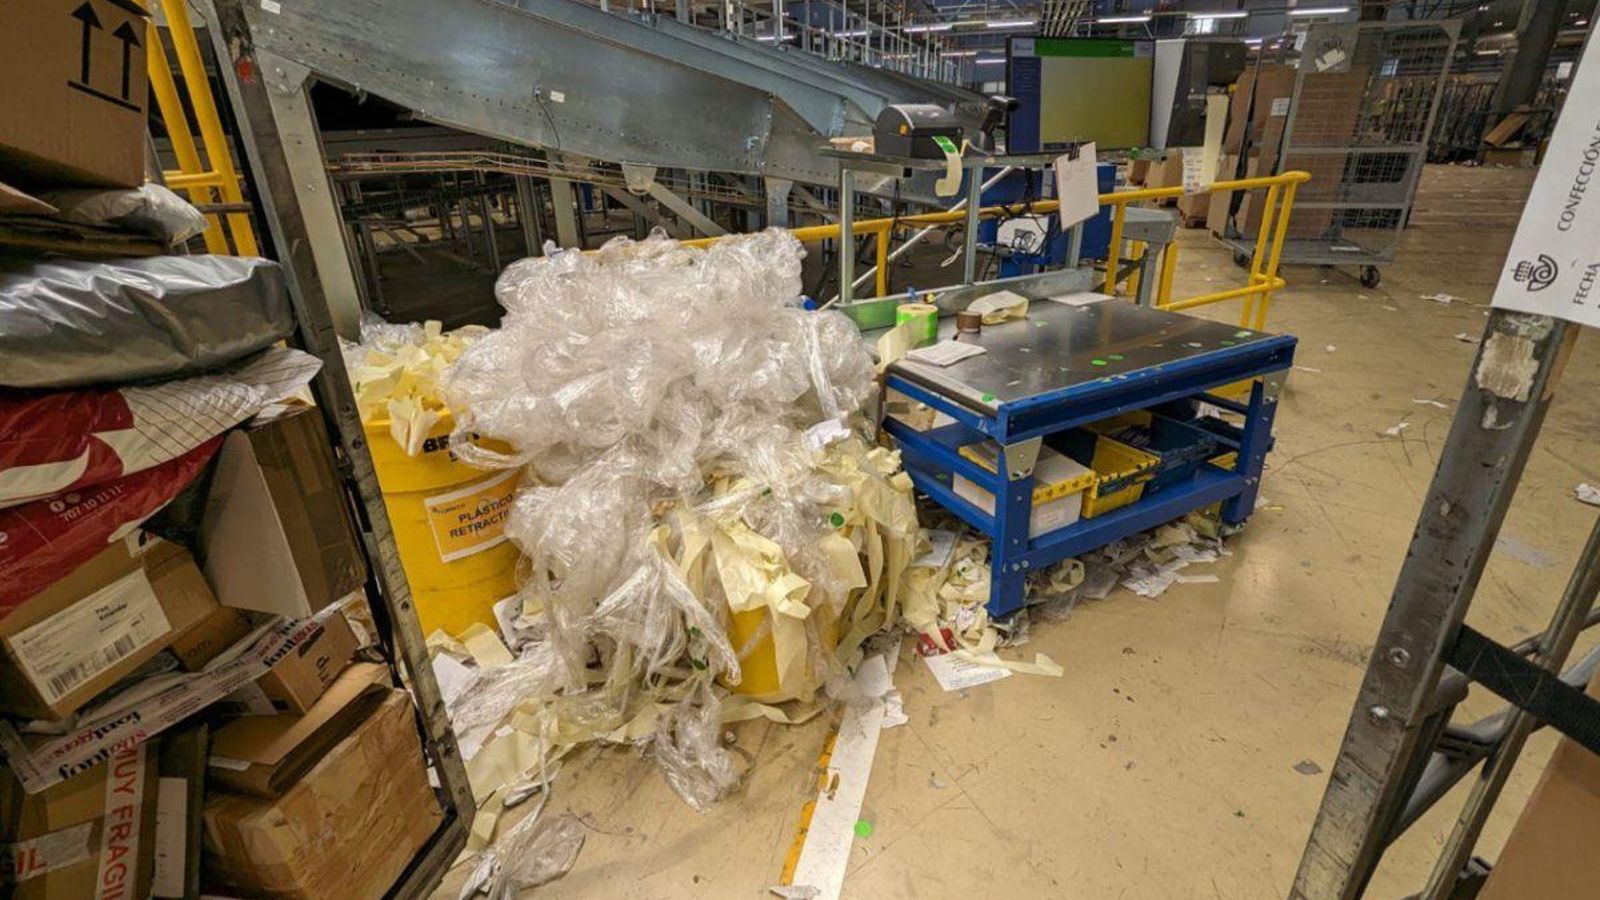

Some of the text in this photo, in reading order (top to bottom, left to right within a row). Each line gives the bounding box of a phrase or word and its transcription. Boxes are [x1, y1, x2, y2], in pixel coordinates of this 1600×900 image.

[1557, 136, 1600, 232] CONFECCIÓN
[1573, 263, 1600, 305] FECHA
[112, 748, 138, 796] MUY
